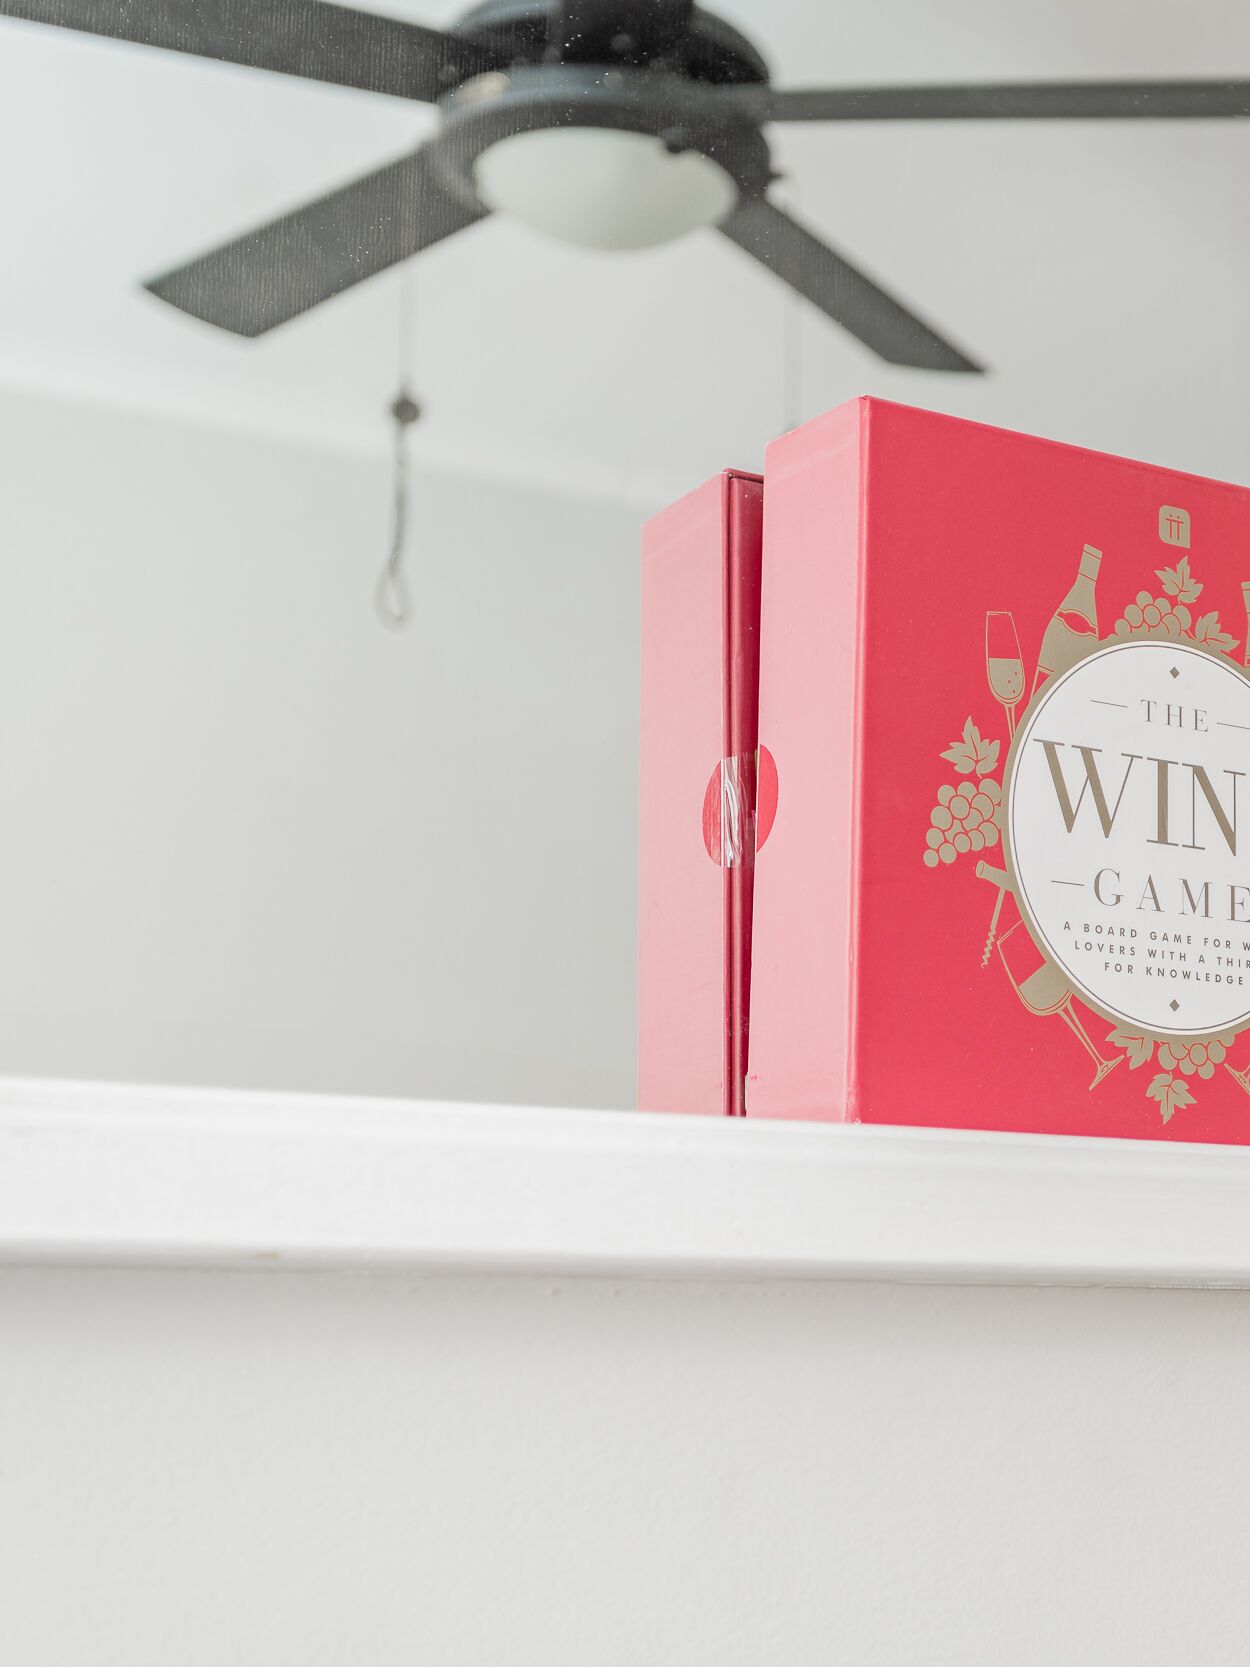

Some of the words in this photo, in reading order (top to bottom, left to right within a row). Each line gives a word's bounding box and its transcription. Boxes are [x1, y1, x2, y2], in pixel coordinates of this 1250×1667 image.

[1140, 699, 1209, 733] THE
[1063, 921, 1072, 932] A
[1083, 923, 1138, 939] BOARD
[1149, 931, 1192, 945] GAME
[1203, 937, 1232, 950] FOR
[1074, 939, 1137, 957] LOVERS
[1147, 948, 1187, 962] WITH
[1198, 954, 1206, 965] A
[1104, 961, 1134, 975] FOR
[1145, 966, 1244, 986] KNOWLEDGE
